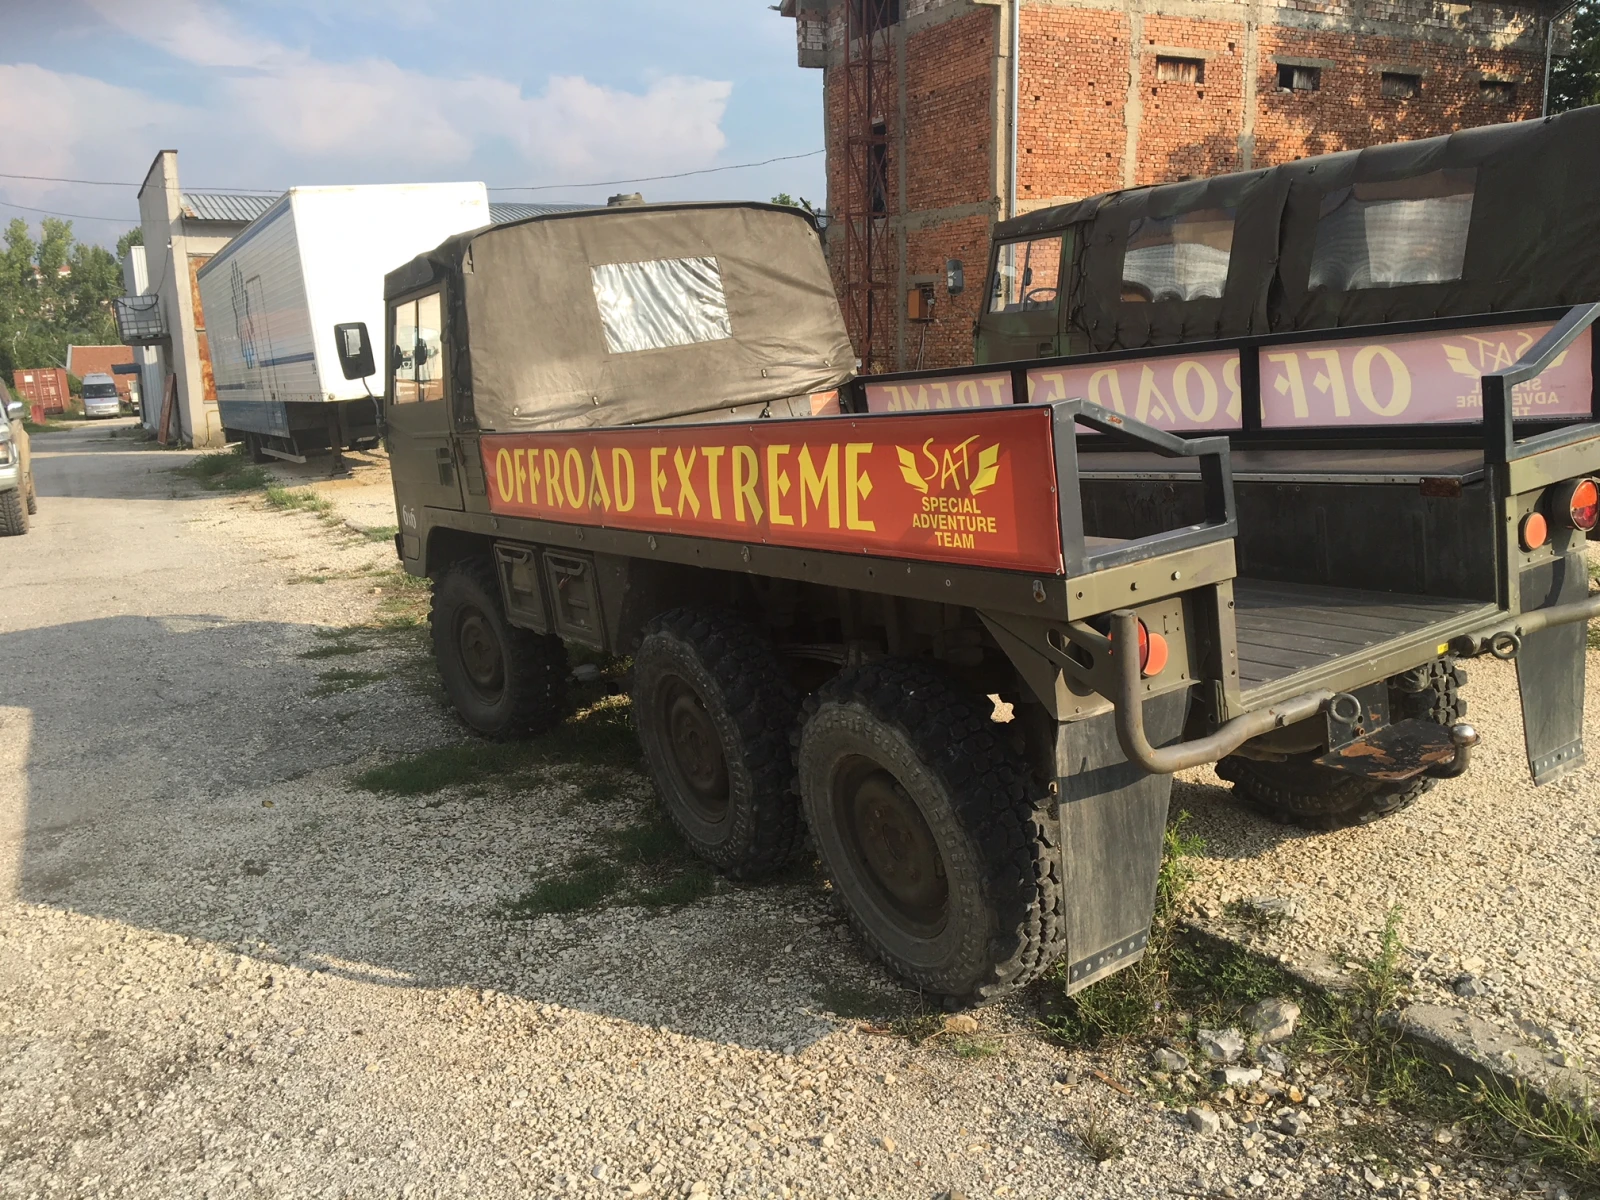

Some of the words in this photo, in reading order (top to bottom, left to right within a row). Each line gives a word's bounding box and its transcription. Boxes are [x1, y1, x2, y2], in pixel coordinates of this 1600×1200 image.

[922, 434, 980, 491] SAT
[495, 446, 635, 513] OFFROAD
[651, 442, 876, 532] EXTREME
[921, 496, 982, 514] SPECIAL
[912, 513, 998, 533] ADVENTURE
[934, 531, 975, 549] TEAM
